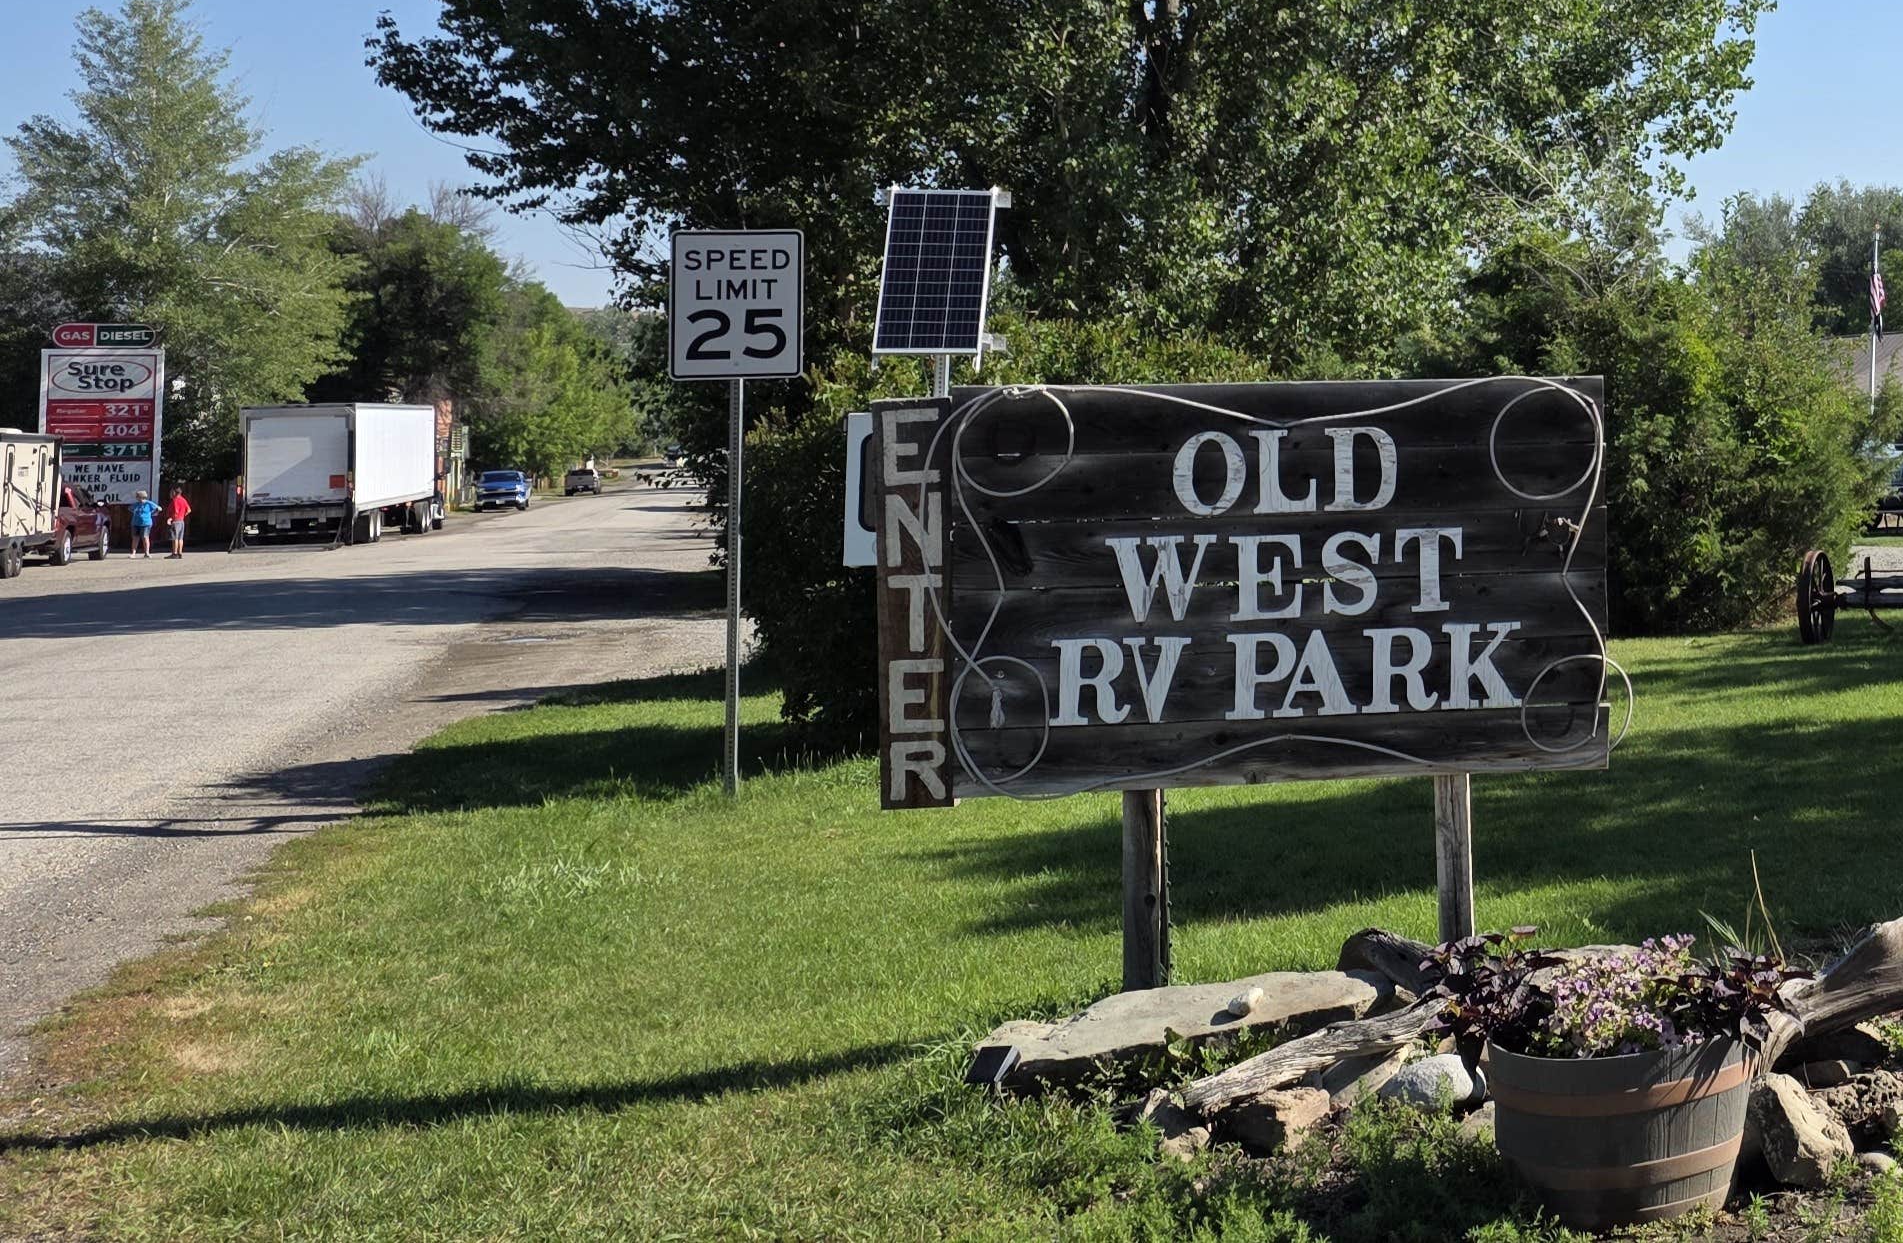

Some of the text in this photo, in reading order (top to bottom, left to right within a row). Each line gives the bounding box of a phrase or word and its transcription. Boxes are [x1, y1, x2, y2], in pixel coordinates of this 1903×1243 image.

[684, 249, 790, 271] SPEED
[695, 279, 778, 301] LIMIT
[60, 331, 151, 341] GAS DIESEL
[685, 308, 787, 361] 25
[67, 361, 126, 377] Sure
[77, 375, 135, 393] Stop
[63, 473, 141, 483] LINKER FLUID
[74, 463, 125, 473] WE HAVE
[1171, 425, 1399, 517] OLD
[87, 483, 108, 493] AND
[104, 493, 122, 503] OIL
[1105, 526, 1464, 624] WEST
[880, 407, 946, 802] ENTER
[1048, 620, 1523, 728] RV PARK
